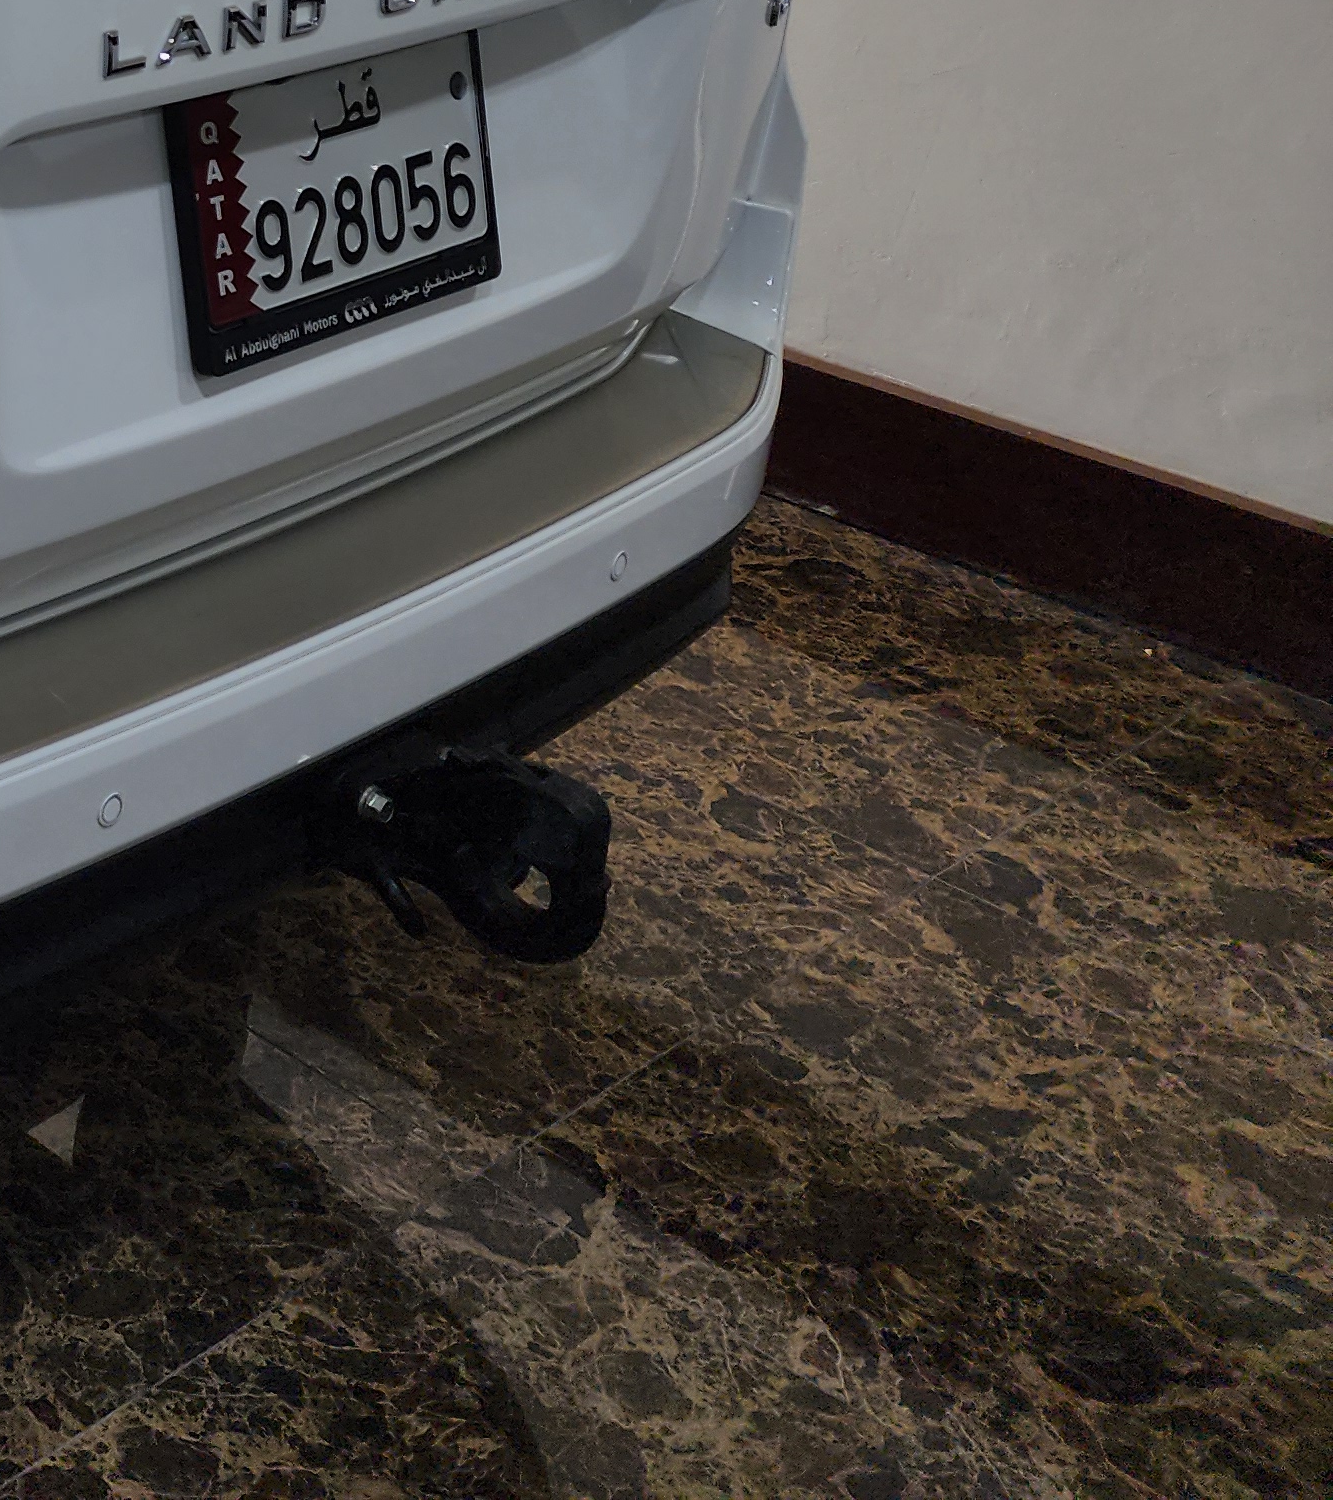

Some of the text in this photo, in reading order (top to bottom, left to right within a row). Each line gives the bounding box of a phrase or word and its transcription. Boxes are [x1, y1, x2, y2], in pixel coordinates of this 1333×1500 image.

[298, 67, 381, 162] قطر
[199, 121, 237, 297] QATAR
[255, 141, 476, 292] 928056
[224, 315, 339, 364] Al Abdulghani Motors
